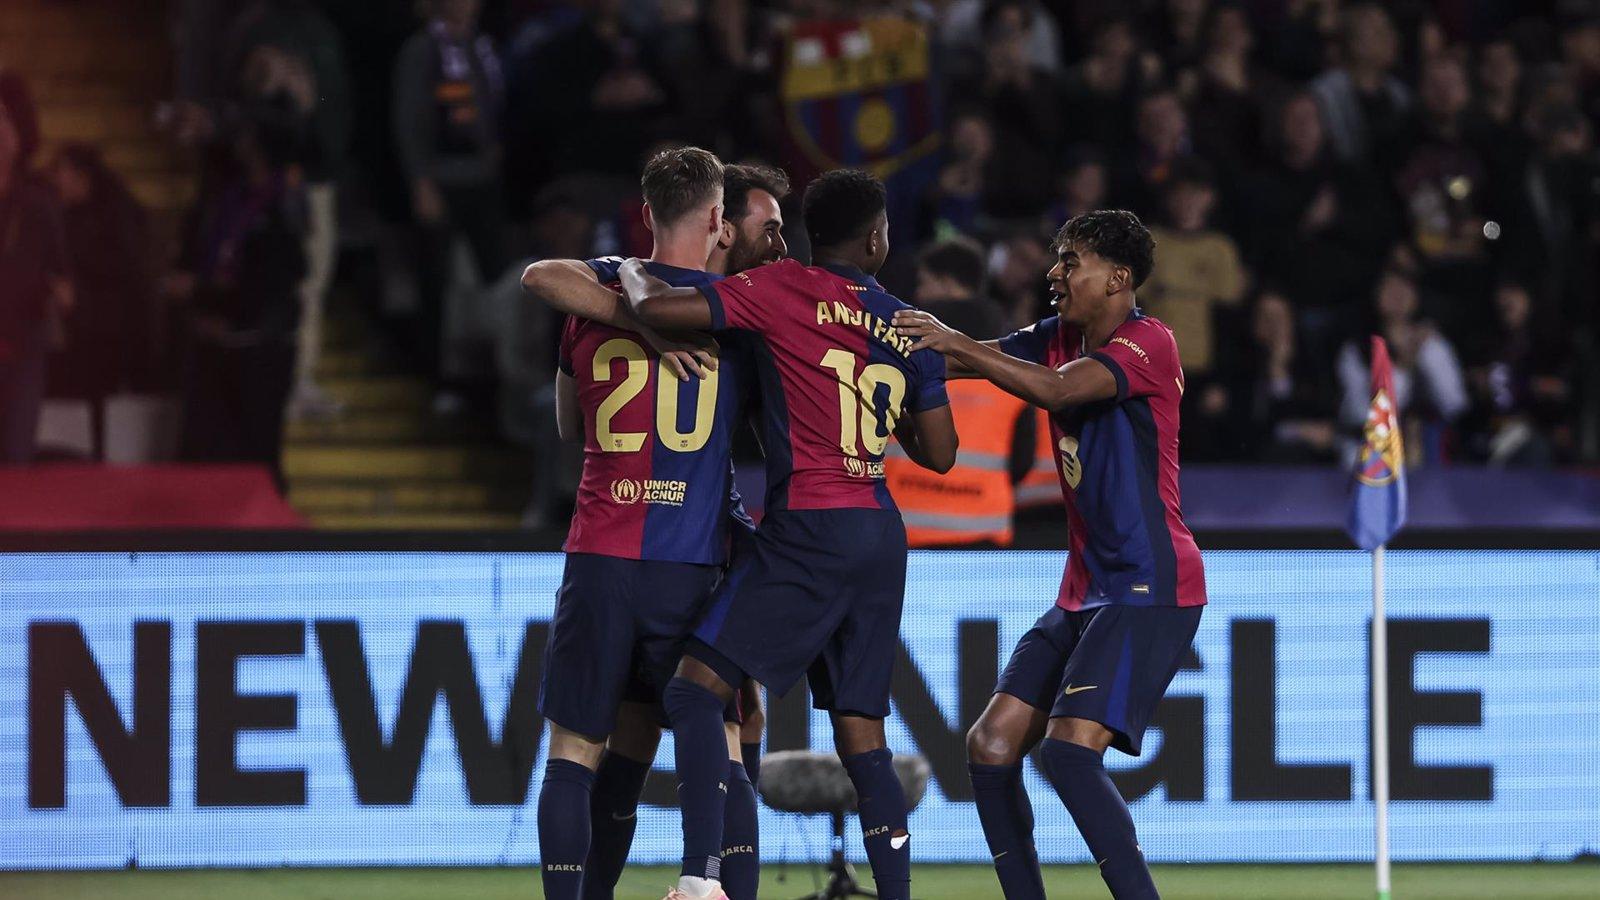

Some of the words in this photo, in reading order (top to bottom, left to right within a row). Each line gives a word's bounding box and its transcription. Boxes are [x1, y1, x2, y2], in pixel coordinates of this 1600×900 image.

[592, 337, 720, 453] 20
[819, 347, 907, 457] 10
[642, 490, 685, 502] ACNUR
[643, 479, 687, 492] UNHCR
[28, 620, 553, 807] NEW
[640, 619, 1493, 803] NGLE
